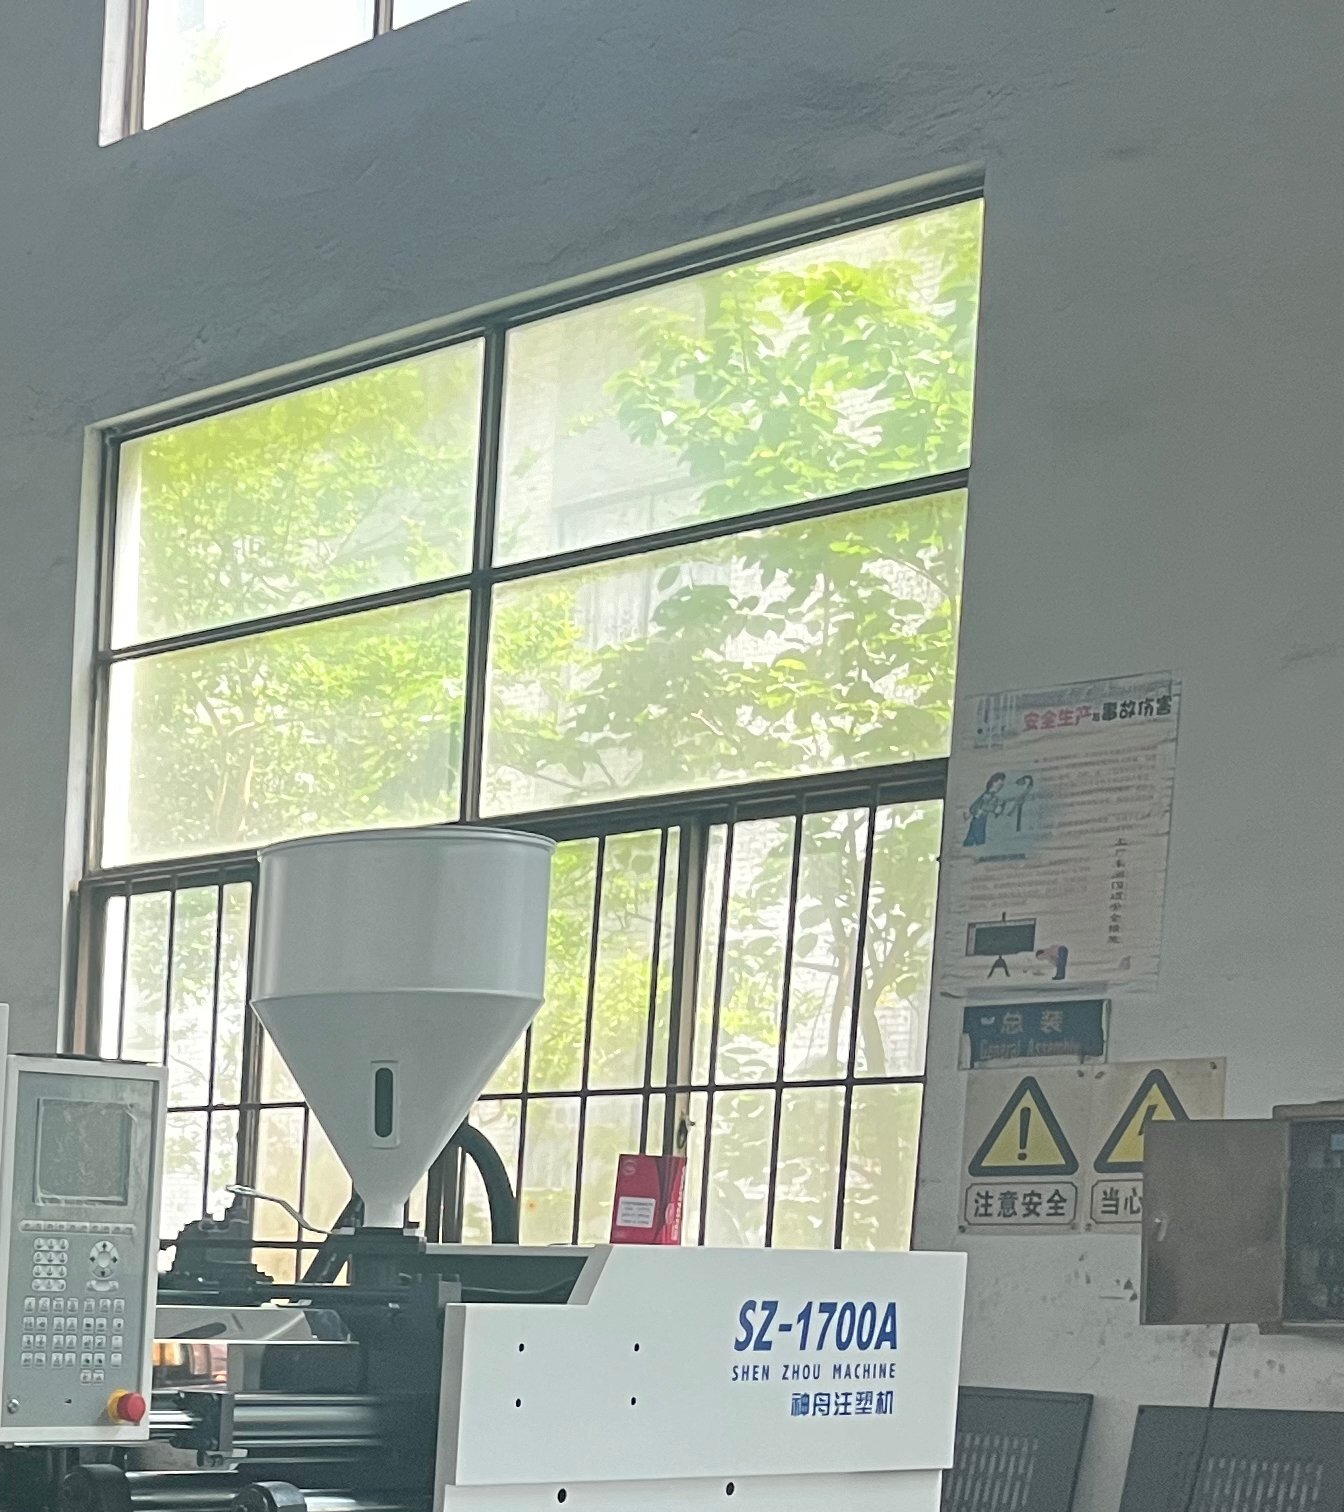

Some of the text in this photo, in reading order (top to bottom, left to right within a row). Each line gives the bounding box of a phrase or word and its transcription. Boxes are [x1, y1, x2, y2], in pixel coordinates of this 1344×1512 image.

[974, 1189, 1067, 1218] 注意安全
[734, 1300, 898, 1352] SZ-1700A
[732, 1363, 897, 1382] SHEN ZHOU MACHINE
[791, 1391, 894, 1417] 神舟注塑机
